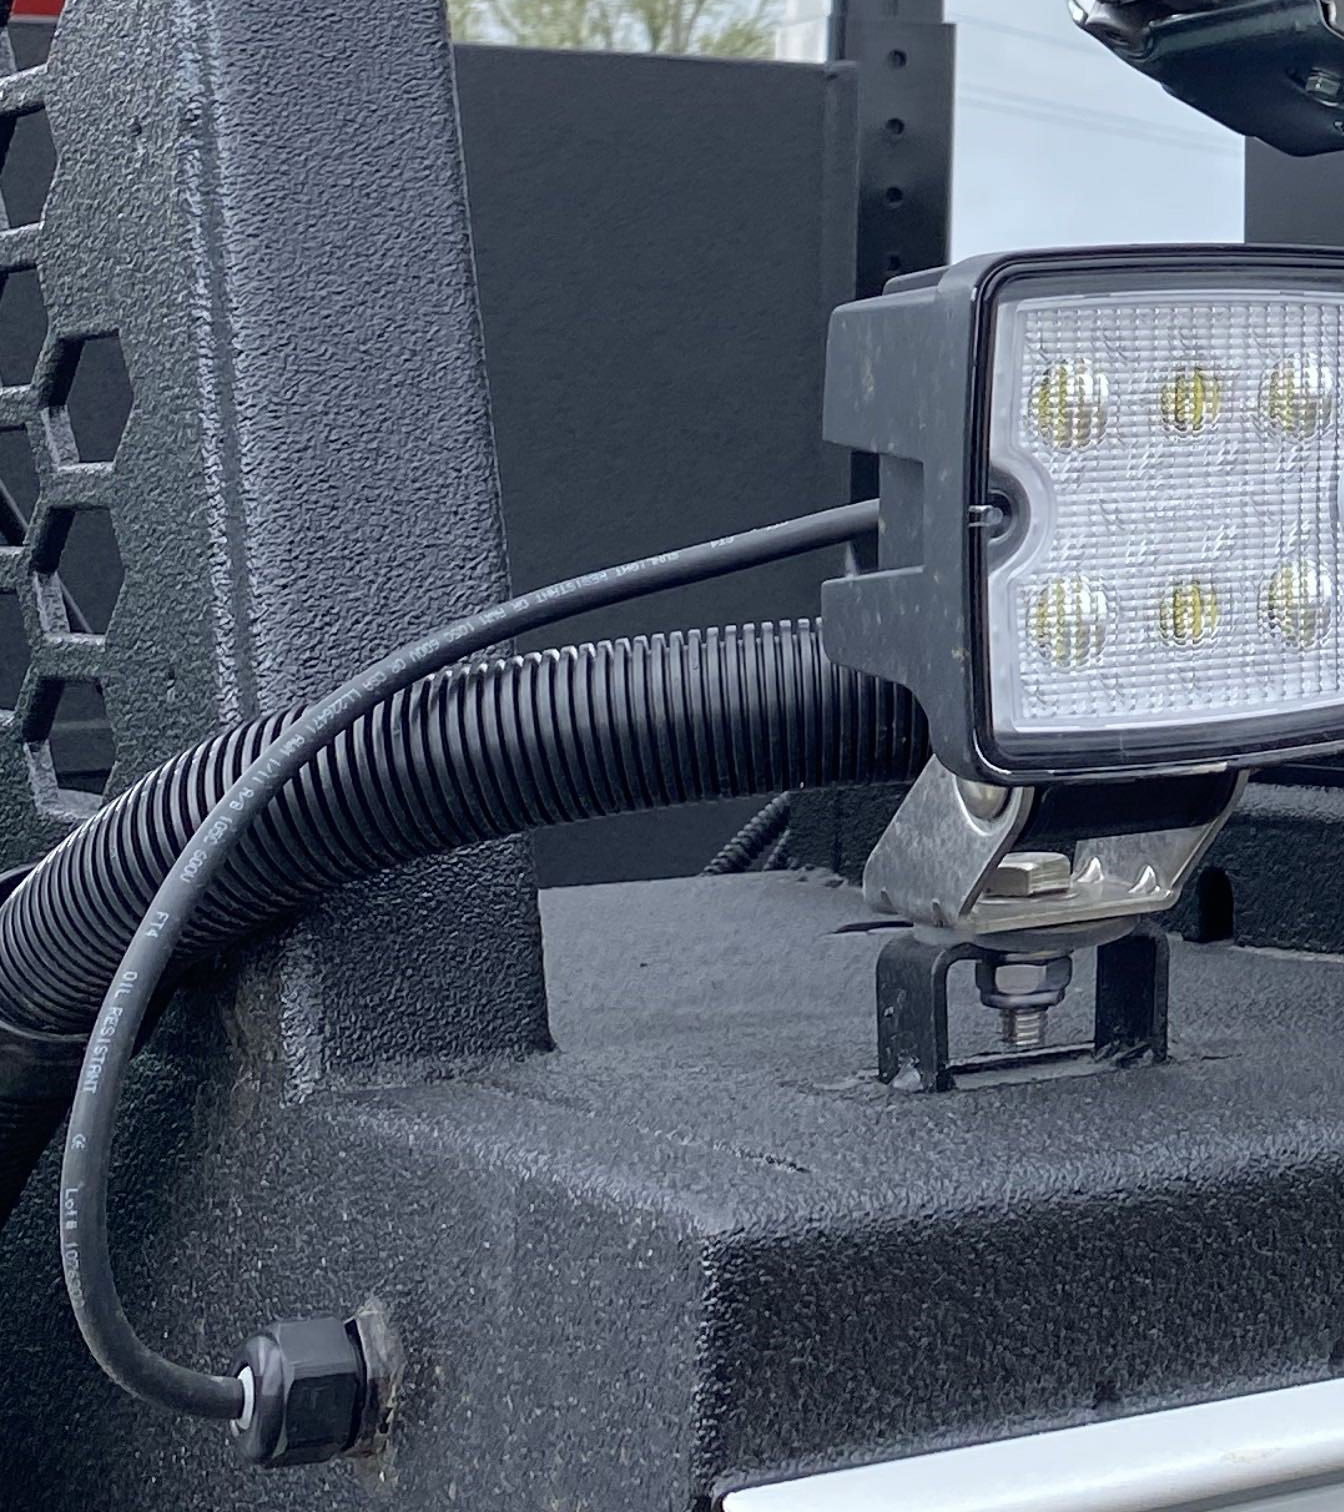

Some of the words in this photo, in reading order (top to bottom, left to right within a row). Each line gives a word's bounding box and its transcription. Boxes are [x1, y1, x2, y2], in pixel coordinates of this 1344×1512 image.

[409, 640, 441, 662] 600V
[144, 910, 170, 938] FT4
[114, 971, 138, 999] OIL
[82, 1006, 124, 1094] RESISTANT
